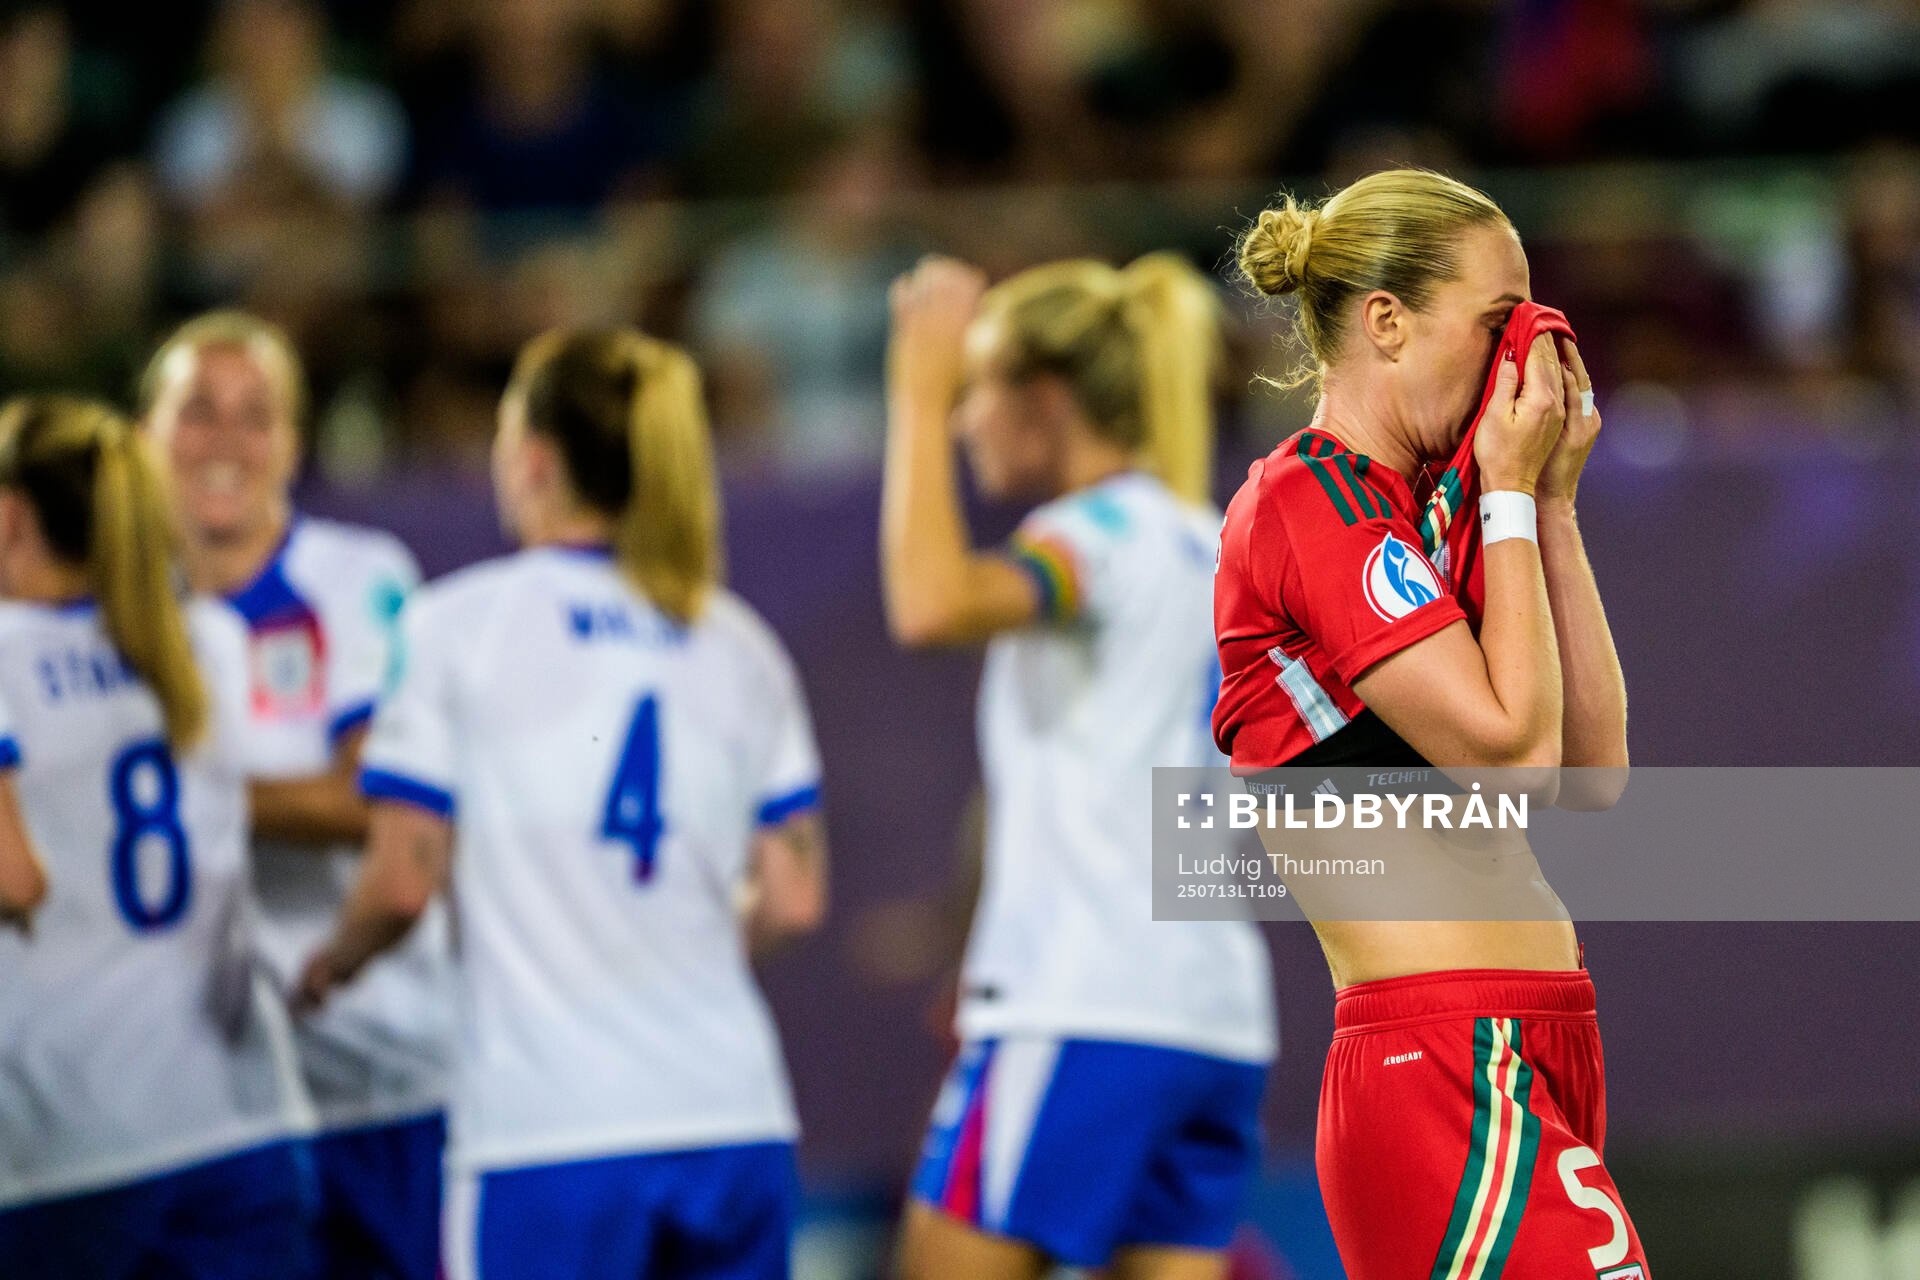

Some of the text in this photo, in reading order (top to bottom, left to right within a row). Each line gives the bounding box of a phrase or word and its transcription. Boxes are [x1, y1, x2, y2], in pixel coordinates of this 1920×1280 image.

[111, 737, 190, 932] 8
[598, 690, 665, 884] 4
[1366, 770, 1431, 787] TECHFIT
[1557, 1145, 1629, 1270] 5
